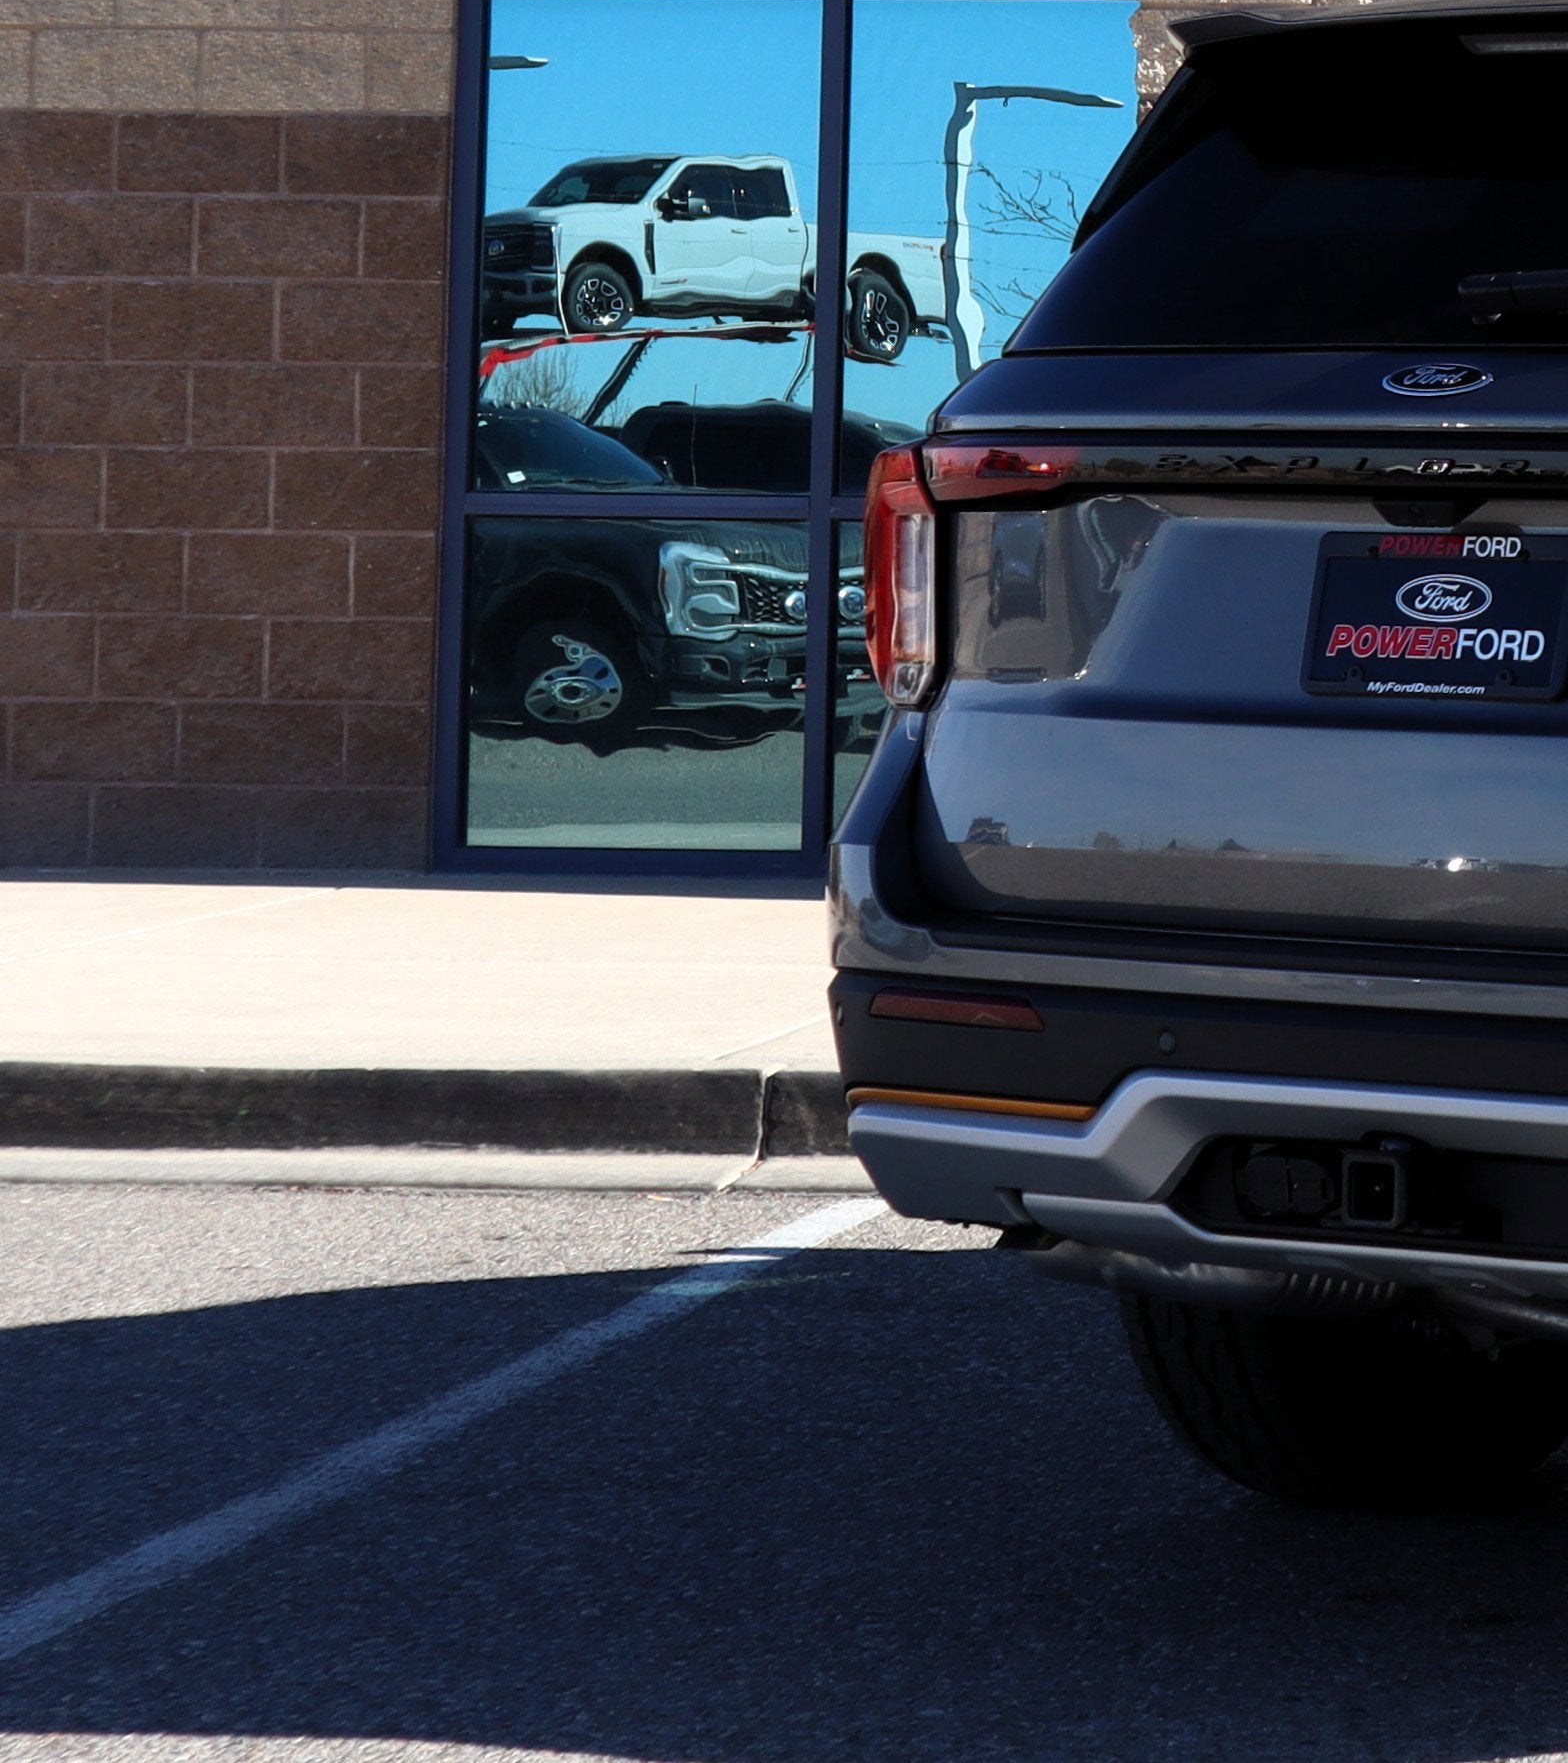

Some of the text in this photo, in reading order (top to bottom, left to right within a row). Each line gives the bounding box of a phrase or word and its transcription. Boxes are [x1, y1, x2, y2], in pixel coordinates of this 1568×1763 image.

[1403, 365, 1469, 385] Ford
[1414, 582, 1472, 612] Ford
[1366, 681, 1486, 695] MyFordDealer.com
